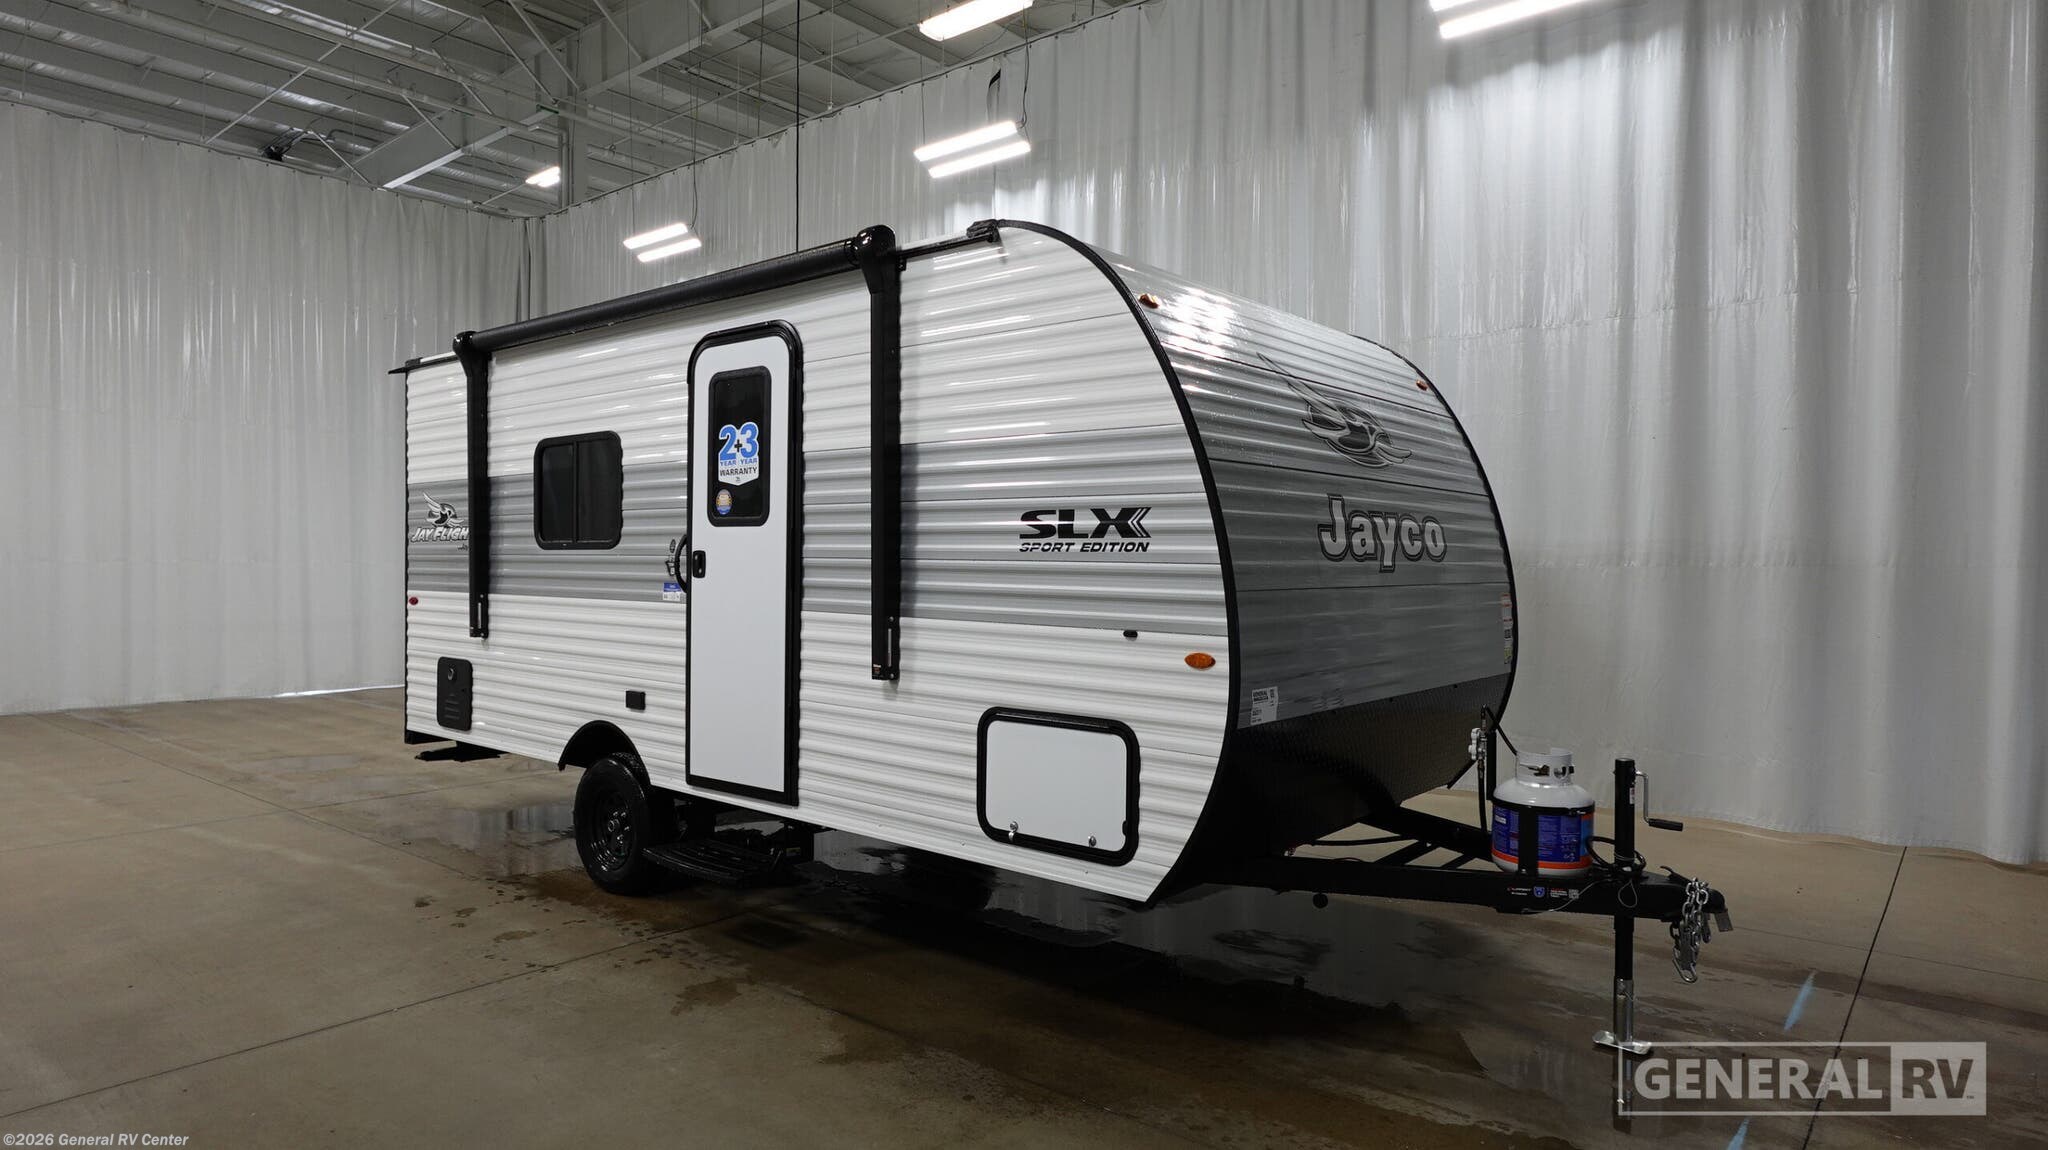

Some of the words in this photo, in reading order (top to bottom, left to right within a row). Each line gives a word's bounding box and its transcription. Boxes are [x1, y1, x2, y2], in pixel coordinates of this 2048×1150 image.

[720, 467, 757, 476] WARRANTY
[1019, 507, 1152, 539] SLX
[410, 527, 434, 543] JAY
[432, 526, 469, 541] FLIGH
[1318, 493, 1447, 573] Jayco
[1019, 542, 1075, 553] SPORT
[1080, 542, 1150, 553] EDITION
